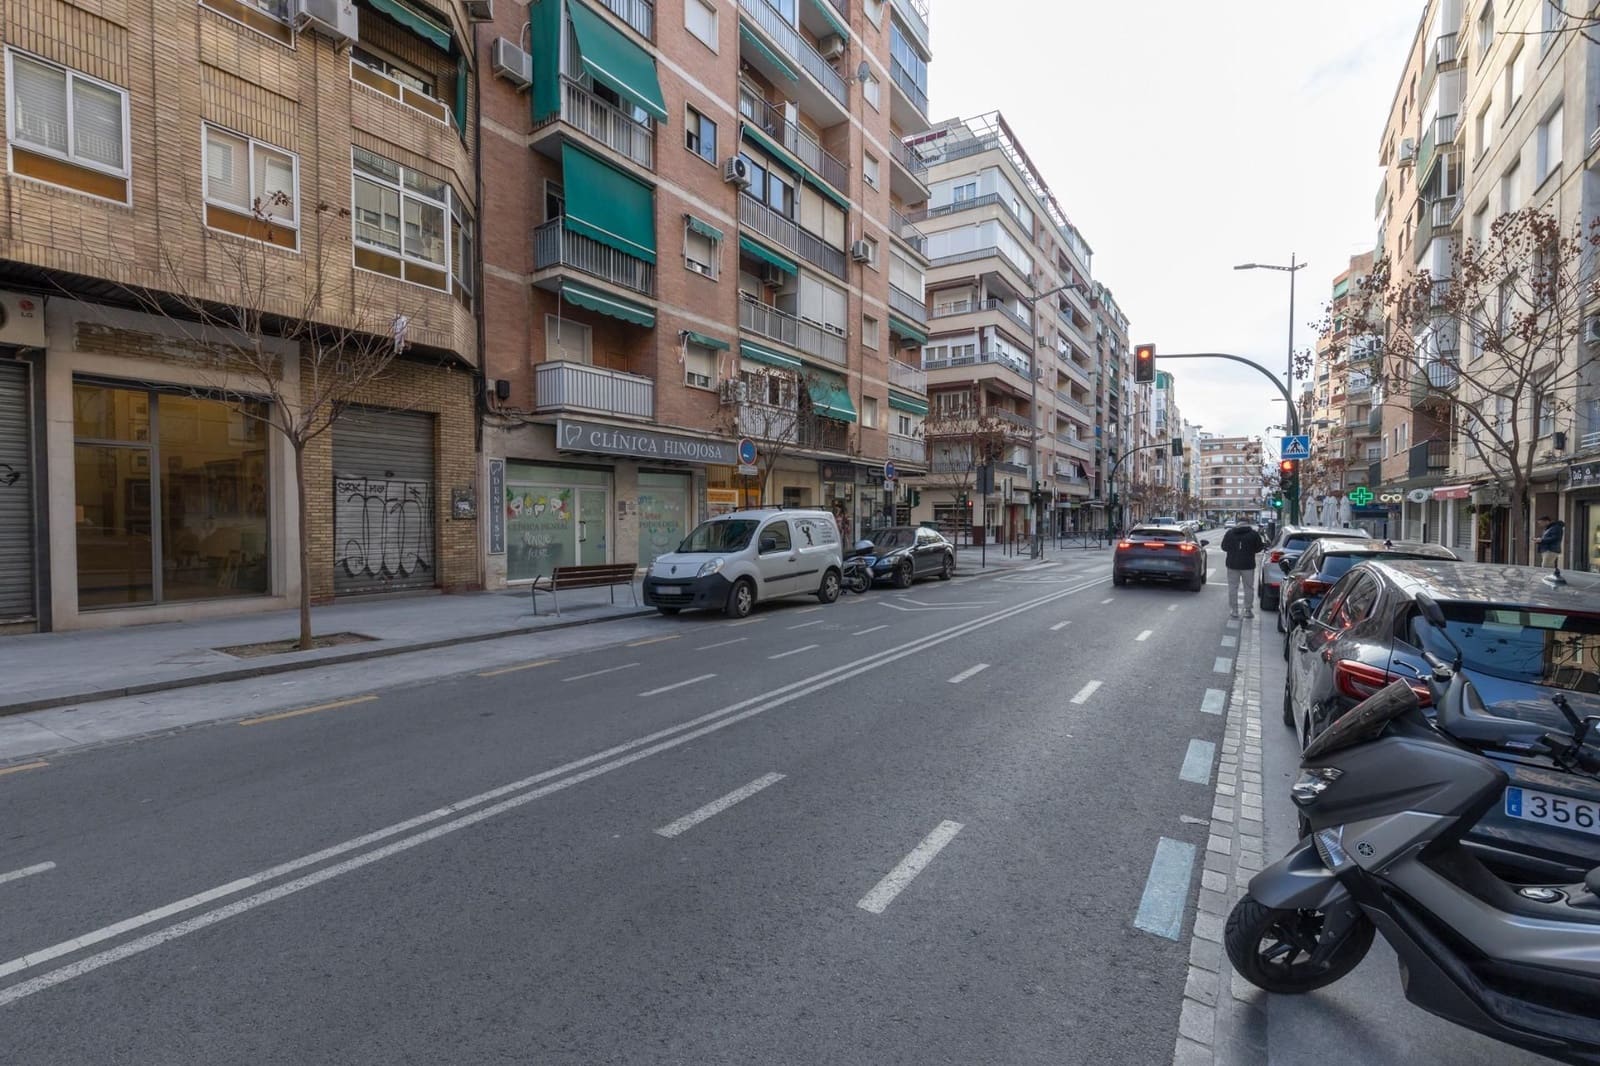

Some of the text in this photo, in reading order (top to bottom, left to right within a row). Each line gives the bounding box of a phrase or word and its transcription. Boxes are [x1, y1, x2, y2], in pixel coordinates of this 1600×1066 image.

[590, 430, 722, 459] CLÍNICA HINOJOSA
[493, 476, 501, 552] DENTISTA
[1530, 796, 1600, 828] 356
